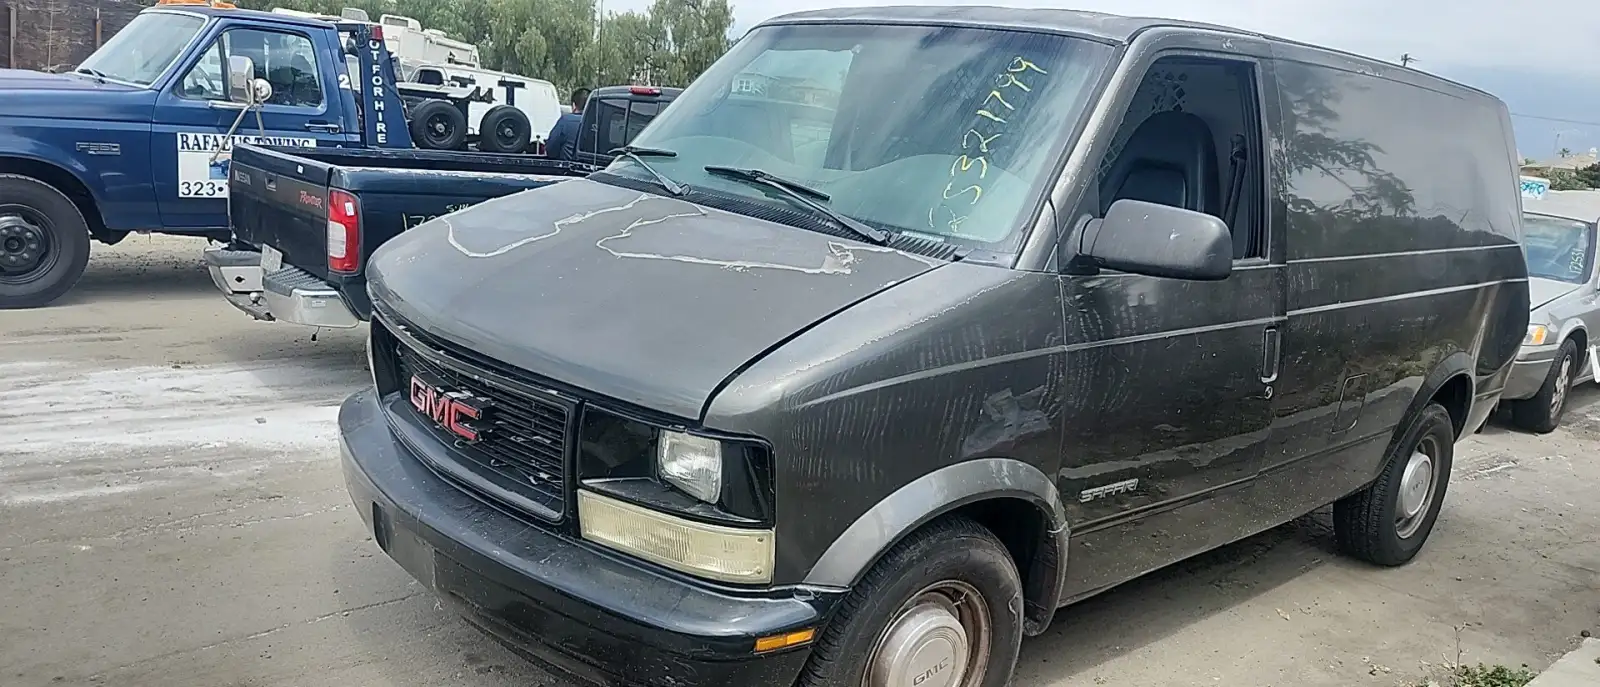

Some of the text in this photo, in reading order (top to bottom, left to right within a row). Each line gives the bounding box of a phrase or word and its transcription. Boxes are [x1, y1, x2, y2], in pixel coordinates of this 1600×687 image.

[371, 64, 384, 97] FOR
[374, 100, 387, 144] HIRE
[410, 374, 480, 441] GMC
[1080, 478, 1139, 503] SAFARI
[913, 657, 949, 687] GMC
